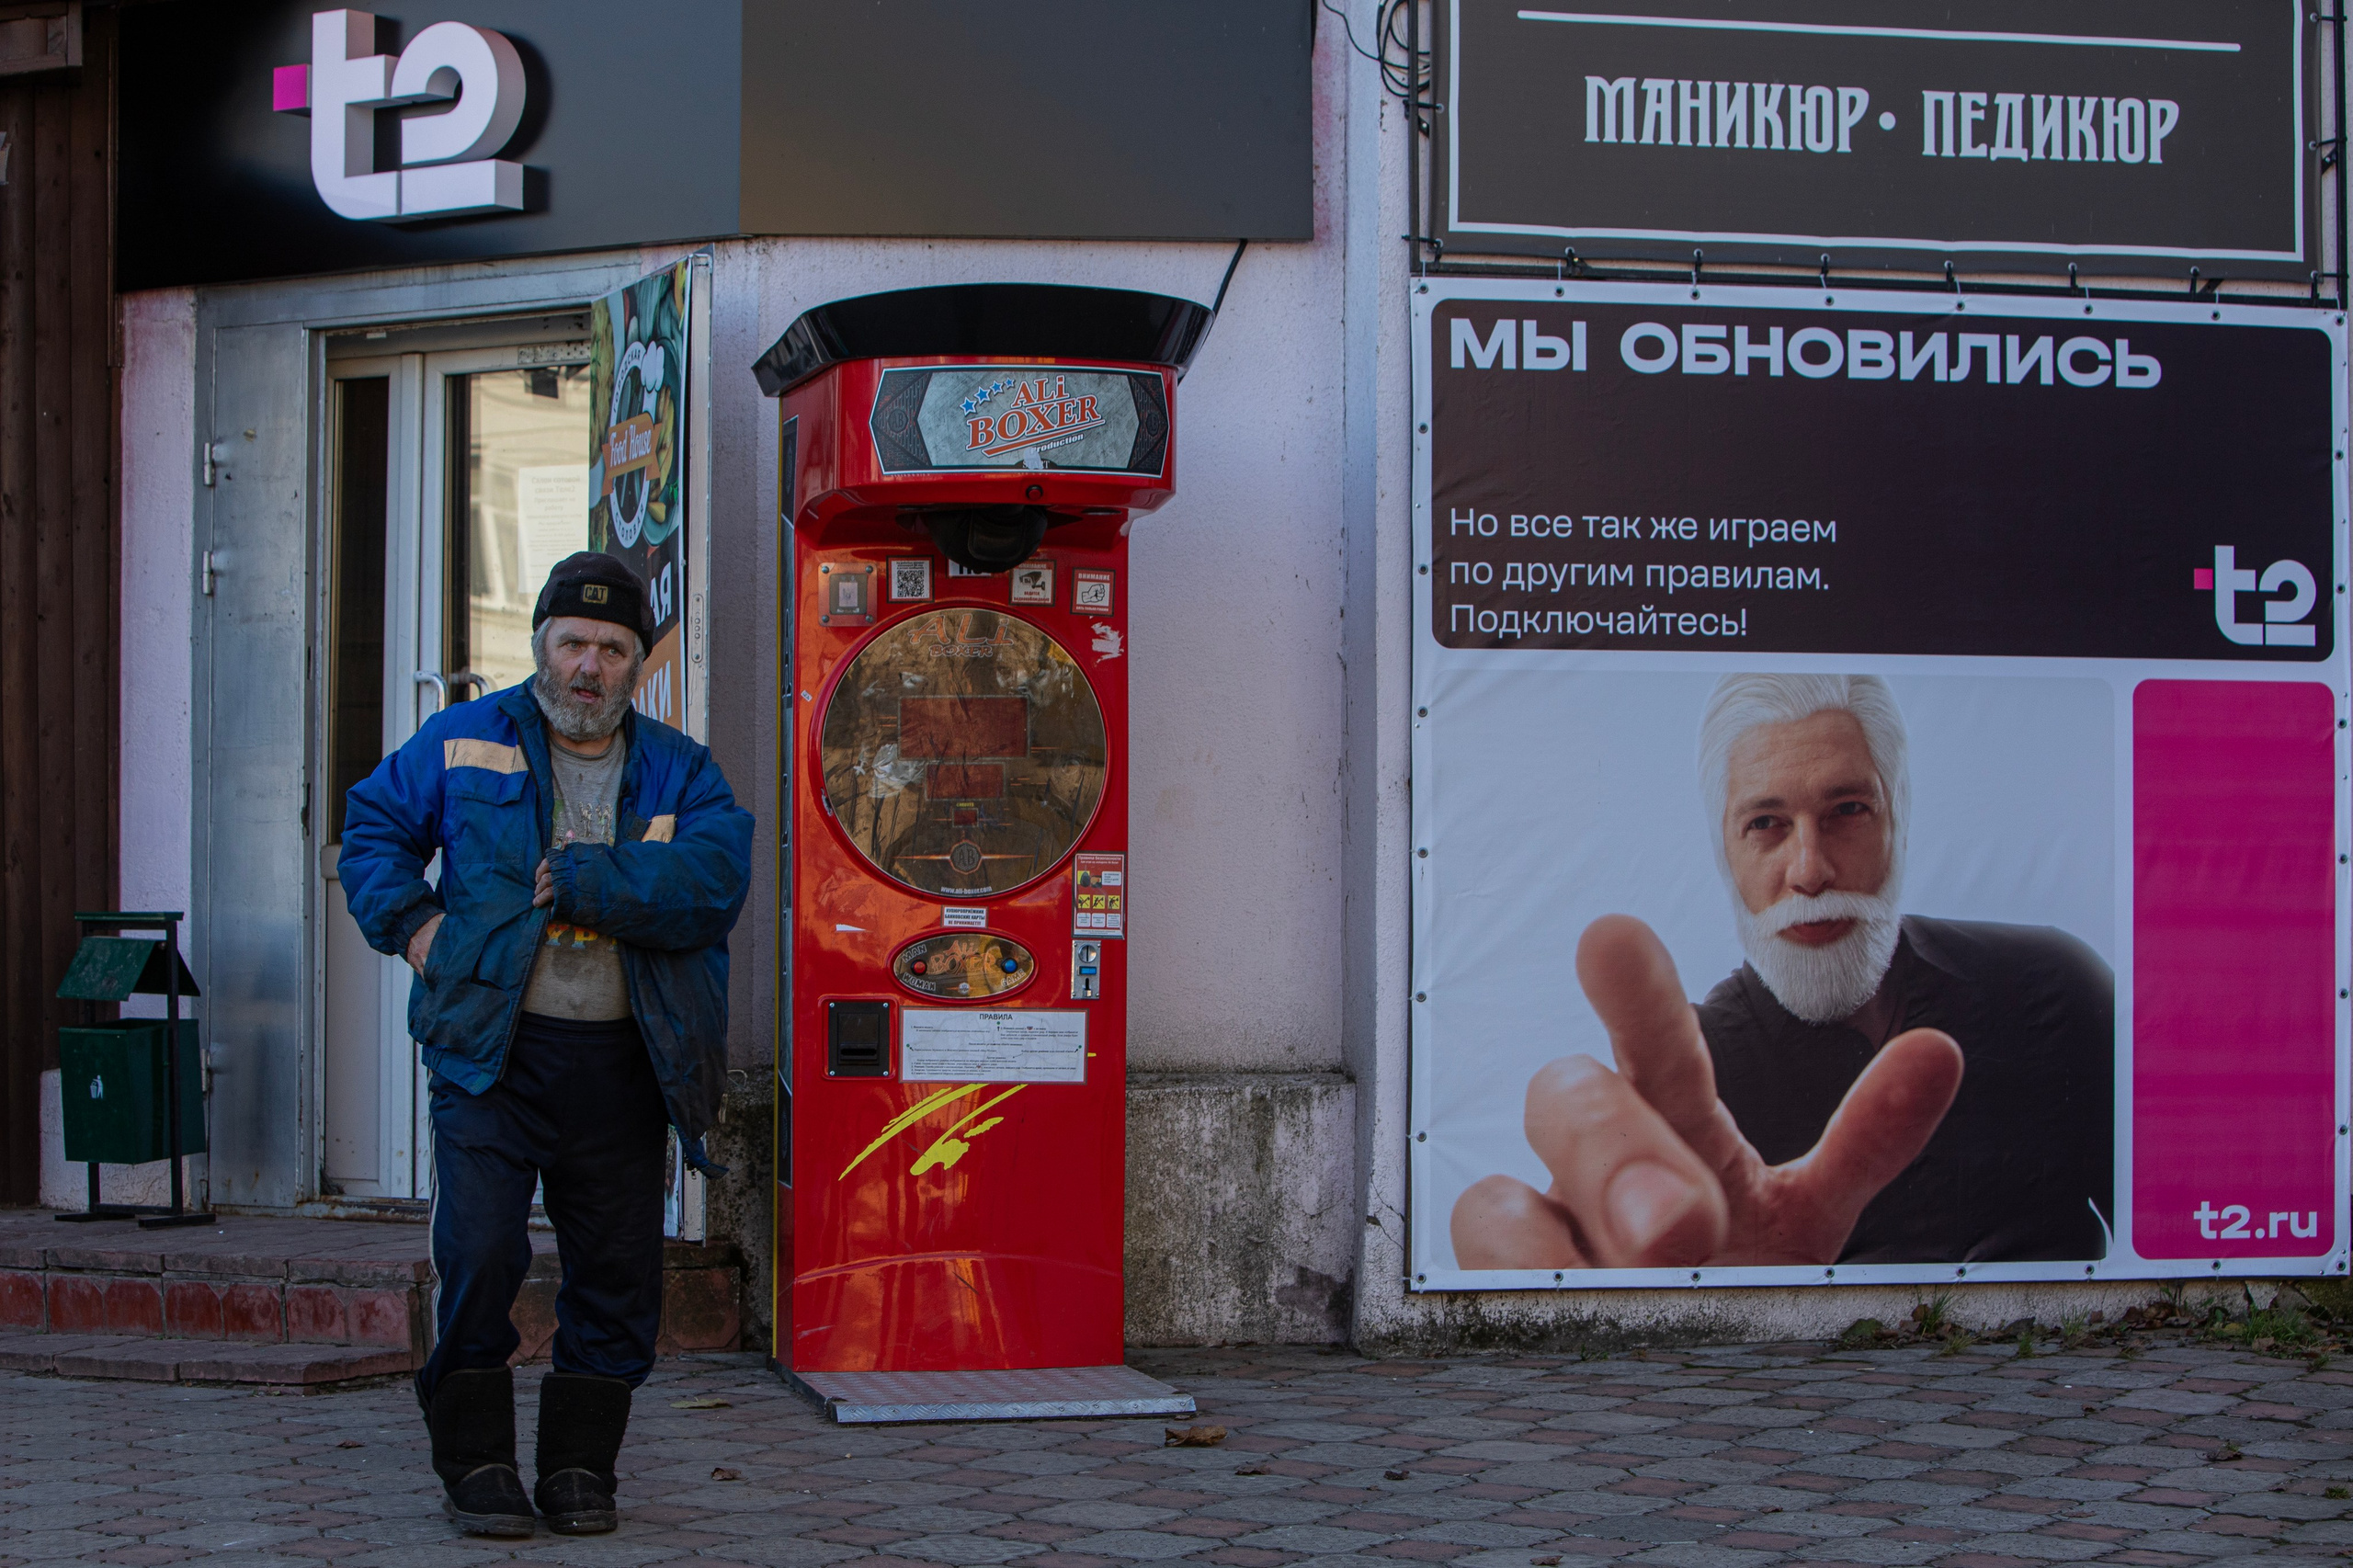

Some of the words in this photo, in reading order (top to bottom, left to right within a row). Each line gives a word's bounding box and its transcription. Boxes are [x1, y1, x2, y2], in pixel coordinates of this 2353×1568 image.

[273, 8, 527, 222] t2
[1585, 75, 1870, 153] МАНИКЮР
[1922, 90, 2179, 164] ПЕДИКЮР
[1450, 318, 1586, 370] МЫ
[1620, 322, 2163, 388] ОБНОВИЛИСЬ
[966, 394, 1103, 452] BOXER
[609, 429, 628, 467] Food
[629, 424, 653, 459] House
[1450, 507, 1498, 537] Но
[1510, 514, 1573, 538] все
[1582, 516, 1642, 540] так
[1650, 517, 1698, 540] же
[1710, 517, 1836, 548] играем
[585, 587, 607, 602] CAT
[1450, 562, 1493, 585] по
[1502, 562, 1633, 593] другим
[1646, 564, 1829, 595] правилам.
[2193, 545, 2316, 645] t2
[1450, 604, 1746, 639] Подключайтесь!
[929, 644, 994, 658] BOXER
[546, 924, 619, 954] YP
[901, 944, 928, 963] MAN
[902, 971, 937, 992] WOMAN
[1001, 968, 1027, 987] GAME
[979, 1013, 1013, 1021] ПРАВИЛА
[2193, 1201, 2317, 1239] t2.ru
